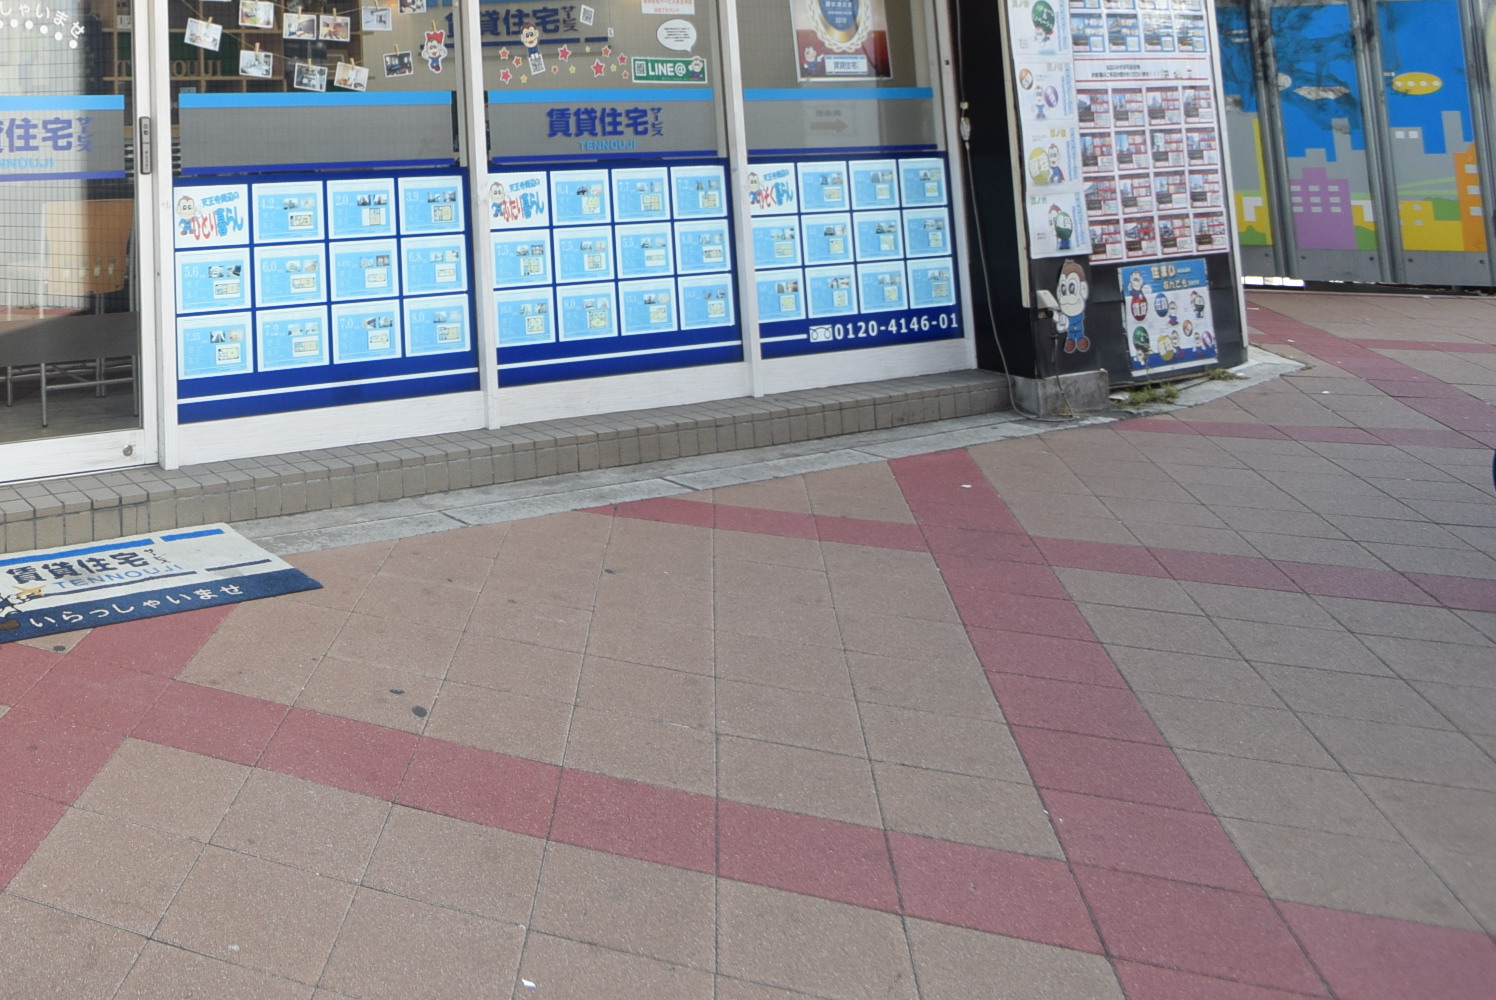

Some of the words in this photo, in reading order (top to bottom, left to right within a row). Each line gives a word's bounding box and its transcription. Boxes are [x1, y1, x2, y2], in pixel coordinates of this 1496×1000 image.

[648, 62, 686, 77] LINE@
[546, 107, 649, 139] 賃貸住宅
[579, 140, 637, 151] TENNOUJI
[184, 265, 199, 278] 5.6
[262, 260, 277, 273] 6.0
[264, 324, 279, 337] 7.2
[834, 312, 958, 340] 0120-4146-01
[5, 550, 151, 585] 賃貸住宅
[52, 564, 184, 590] TENNOUJI
[29, 584, 244, 628] いらっしゃいませ
